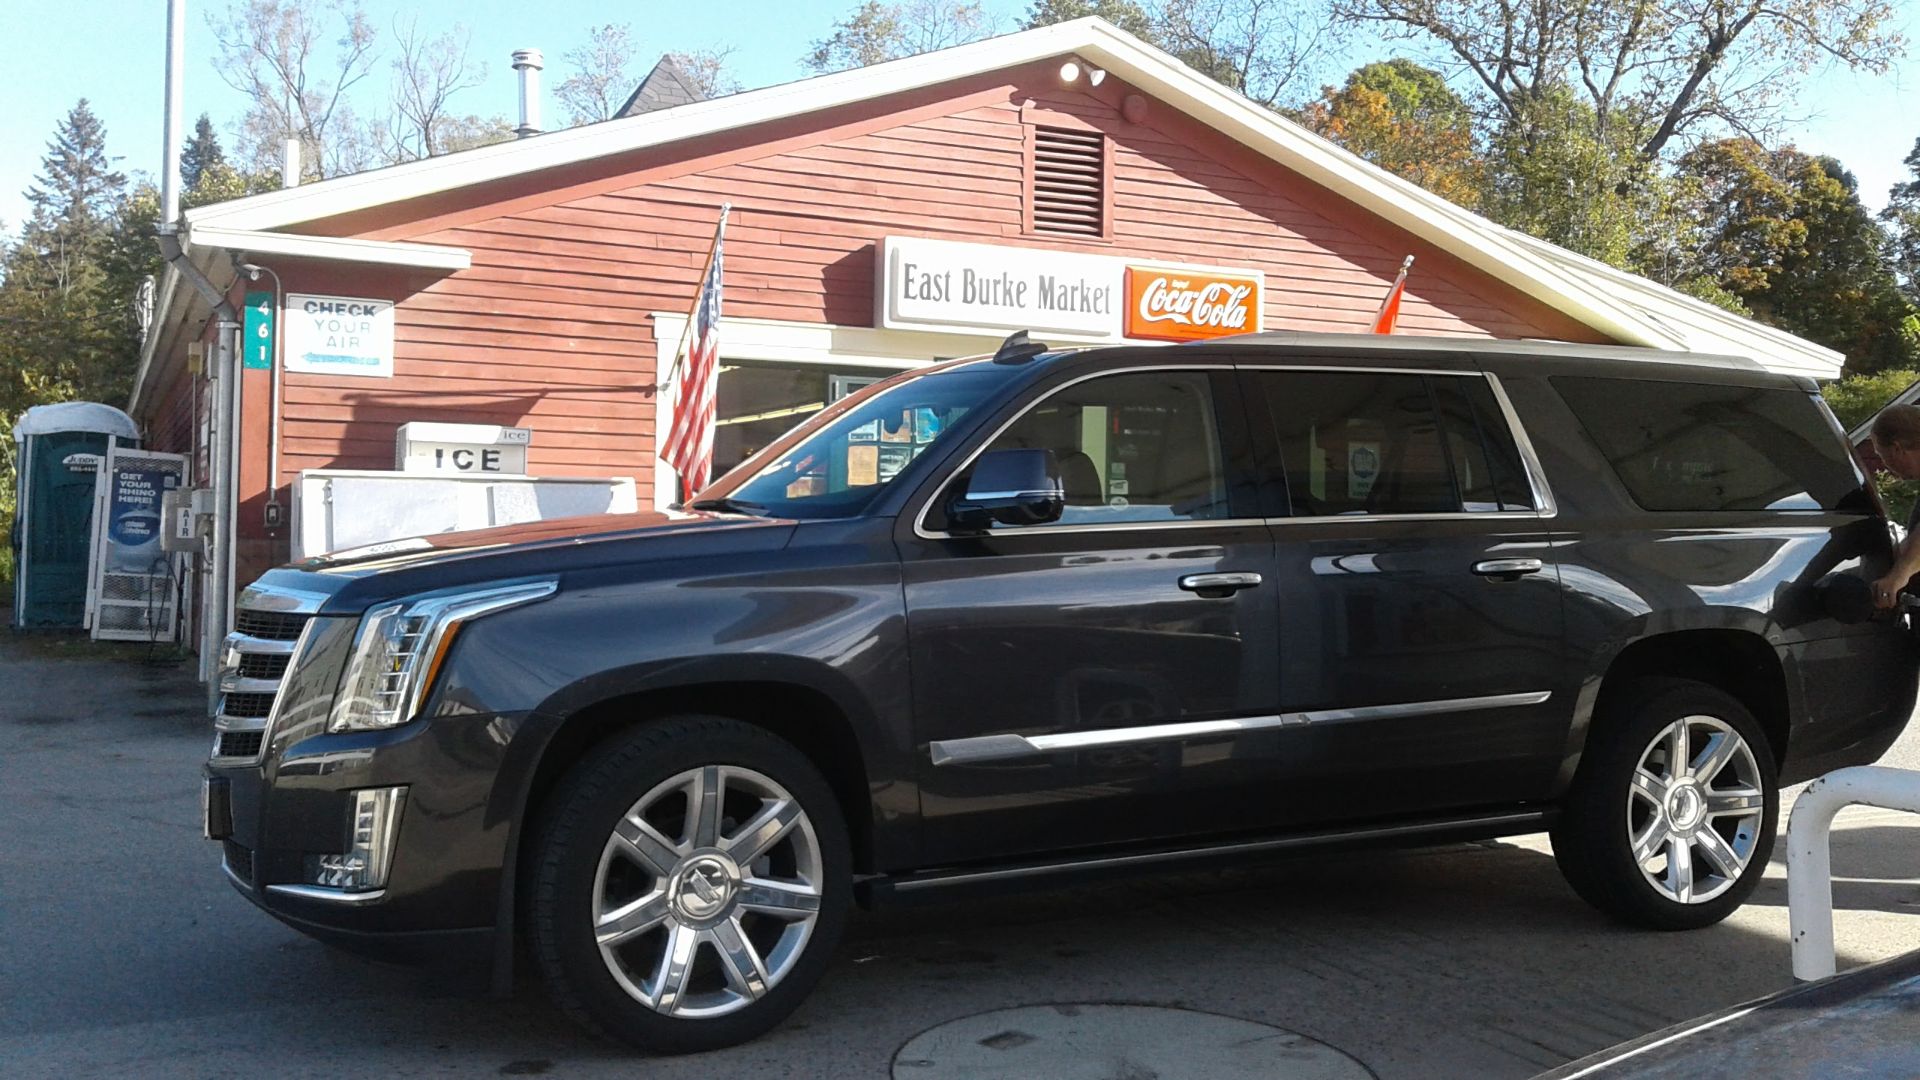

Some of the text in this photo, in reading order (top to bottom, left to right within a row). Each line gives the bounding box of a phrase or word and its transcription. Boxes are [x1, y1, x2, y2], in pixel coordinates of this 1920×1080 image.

[903, 262, 1111, 315] East Burke Market
[303, 301, 378, 317] CHECK
[1139, 277, 1252, 328] Coca-Cola
[257, 301, 269, 361] 461
[314, 319, 371, 334] YOUR
[326, 335, 360, 349] AIR
[503, 430, 527, 440] ice
[435, 448, 501, 471] ICE
[120, 472, 144, 481] GET
[119, 480, 152, 489] YOUR
[118, 495, 153, 504] HERE!
[119, 488, 156, 497] RHINO
[182, 509, 190, 537] AIR
